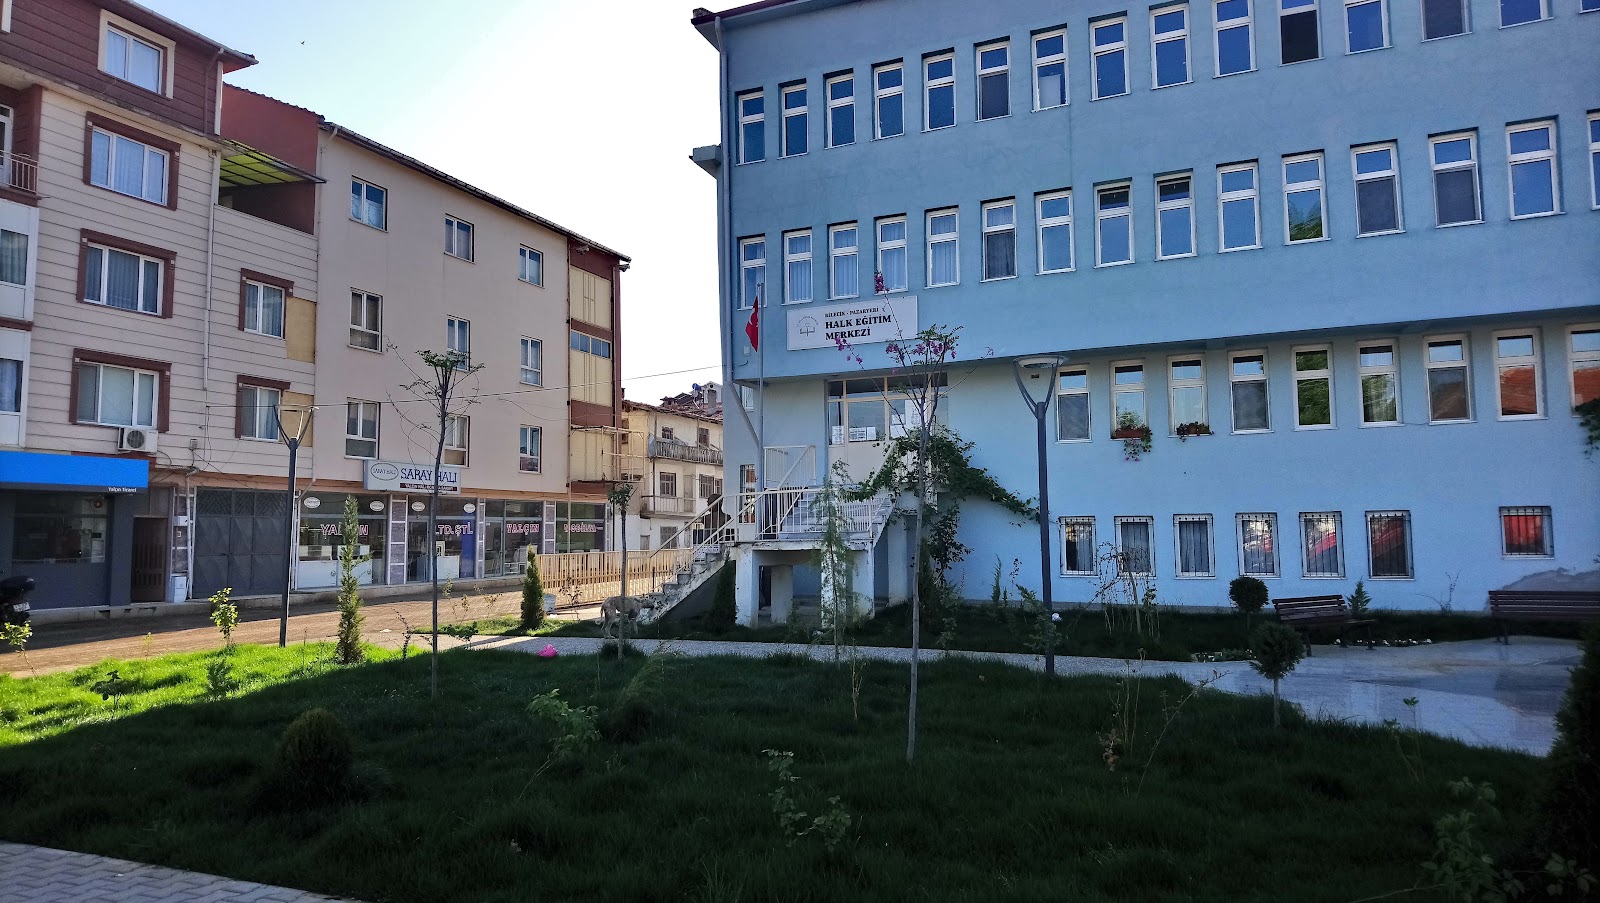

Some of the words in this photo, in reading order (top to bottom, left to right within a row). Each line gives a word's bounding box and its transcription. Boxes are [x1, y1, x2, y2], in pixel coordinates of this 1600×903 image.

[825, 319, 853, 329] HALK
[855, 314, 891, 326] EĞİTİM
[825, 327, 871, 340] MERKEZİ
[400, 468, 433, 480] SARAY
[320, 524, 369, 536] YALN
[506, 523, 540, 535] YALÇIN
